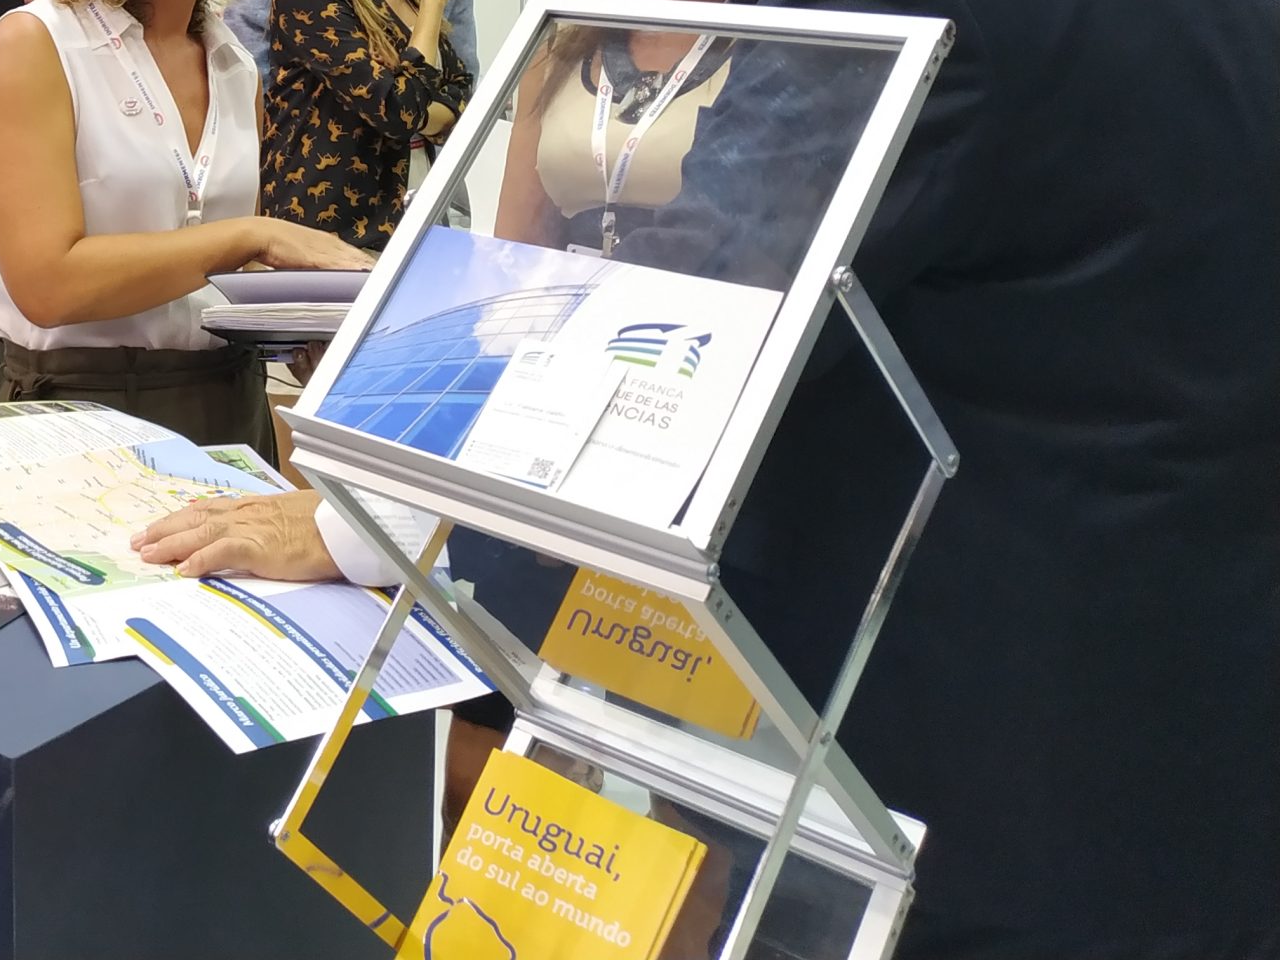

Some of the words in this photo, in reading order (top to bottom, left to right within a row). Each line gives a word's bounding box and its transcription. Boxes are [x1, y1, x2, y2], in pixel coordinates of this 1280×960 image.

[635, 394, 653, 407] DE
[654, 399, 679, 413] LAS
[227, 699, 254, 727] Marco
[466, 823, 525, 862] porta
[527, 854, 598, 900] aberta
[483, 787, 621, 882] Uruguai,
[456, 846, 484, 871] do
[484, 863, 521, 891] sul
[520, 883, 550, 907] ao
[552, 898, 632, 948] mundo
